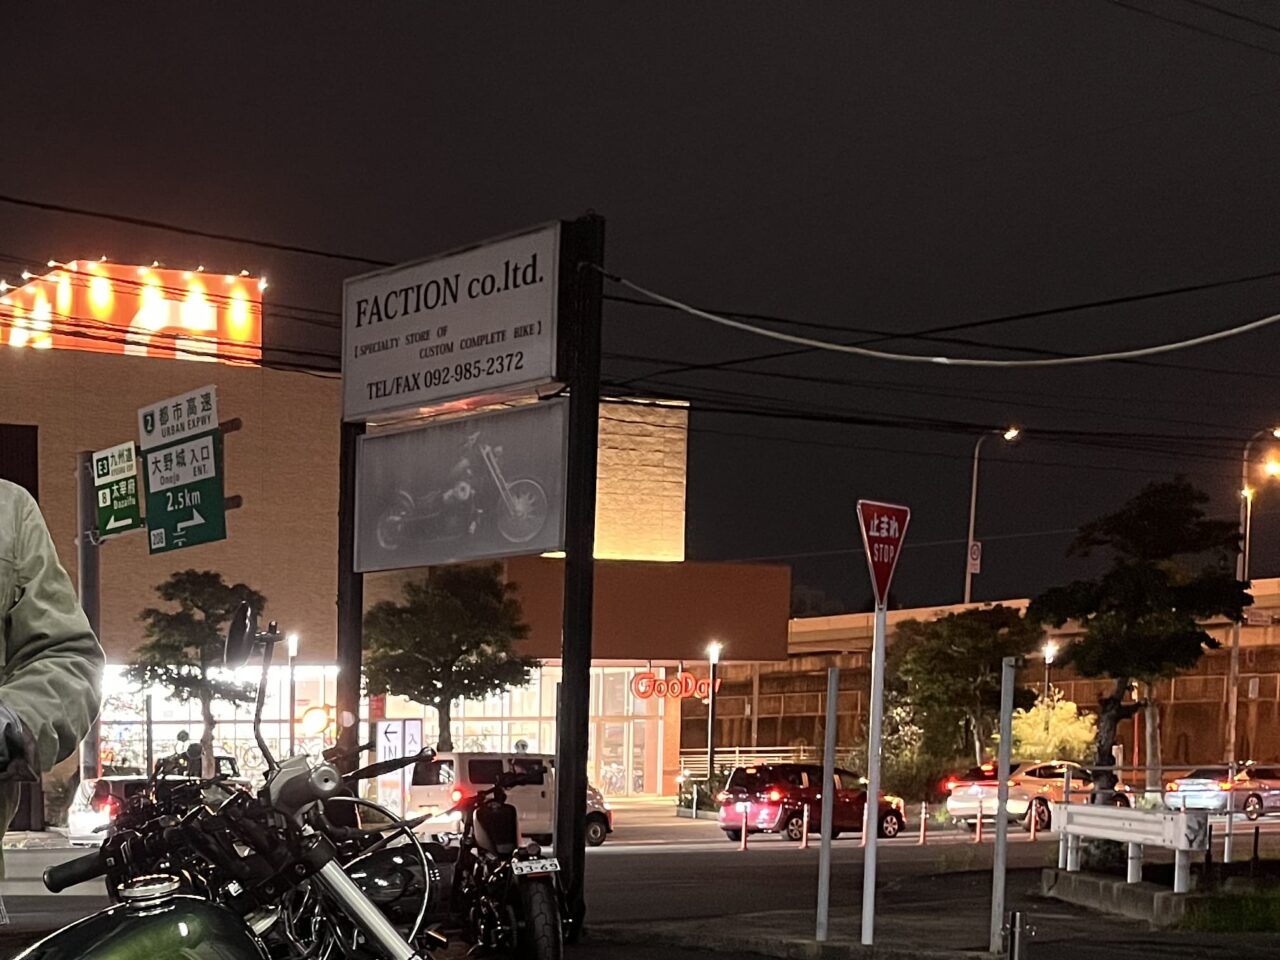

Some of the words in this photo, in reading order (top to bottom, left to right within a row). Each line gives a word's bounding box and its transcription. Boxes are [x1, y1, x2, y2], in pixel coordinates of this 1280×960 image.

[355, 274, 460, 328] FACTION
[467, 253, 544, 299] co.ltd.
[405, 329, 430, 345] STORE
[437, 325, 448, 338] OF
[419, 342, 454, 359] CUSTOM
[460, 329, 506, 350] COMPLETE
[367, 372, 421, 400] TEL/FAX
[424, 351, 524, 388] 092-985-2372
[159, 392, 213, 426] 都市高速
[145, 416, 153, 430] 2
[161, 423, 186, 438] URBAN
[187, 415, 212, 434] EXPWY
[98, 460, 108, 475] E3
[101, 491, 108, 504] 8
[165, 488, 201, 511] 2.5km
[869, 512, 899, 538] 止まれ
[873, 543, 895, 563] STOP
